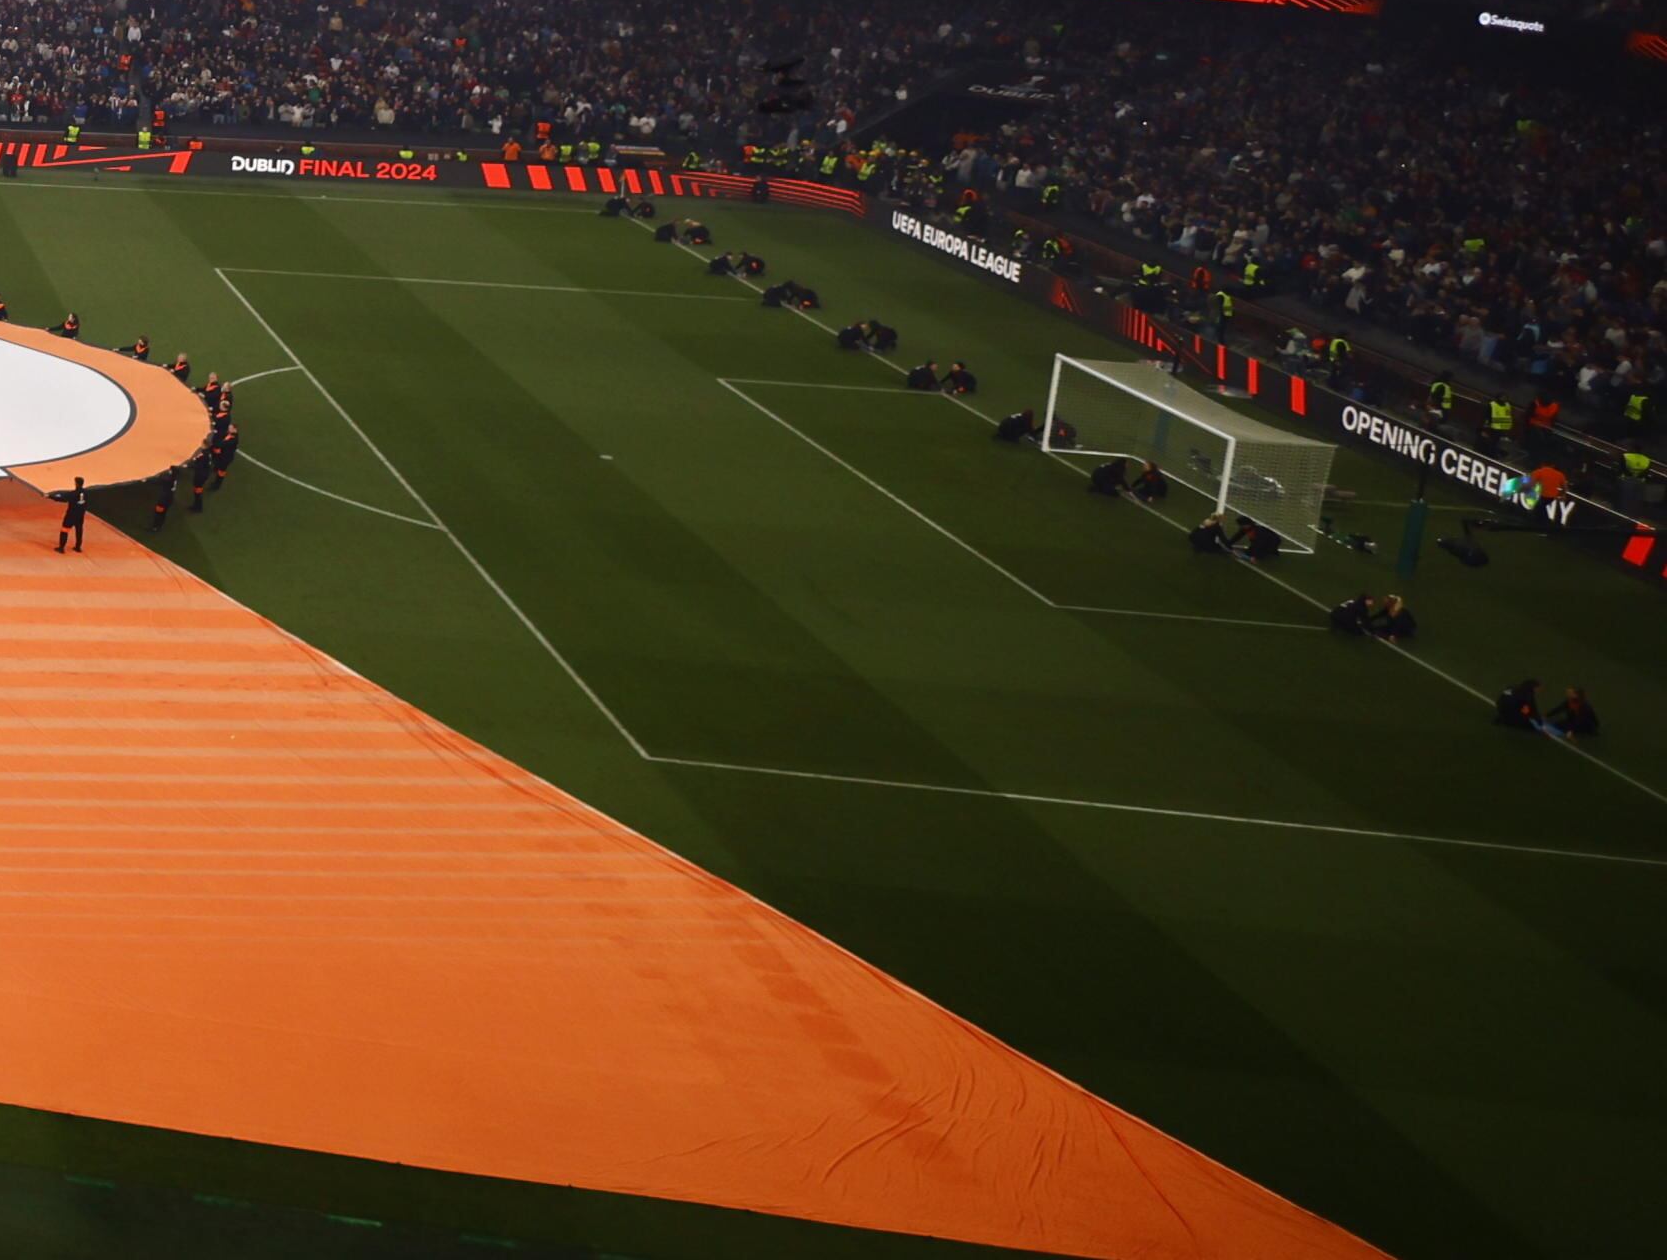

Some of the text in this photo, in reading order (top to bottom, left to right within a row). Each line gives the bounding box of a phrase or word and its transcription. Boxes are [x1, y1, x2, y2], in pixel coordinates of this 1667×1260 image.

[299, 159, 370, 178] FINAL
[376, 161, 437, 180] 2024
[892, 210, 1022, 283] UEFA EUROPA LEAGUE
[1341, 406, 1436, 466] OPENING
